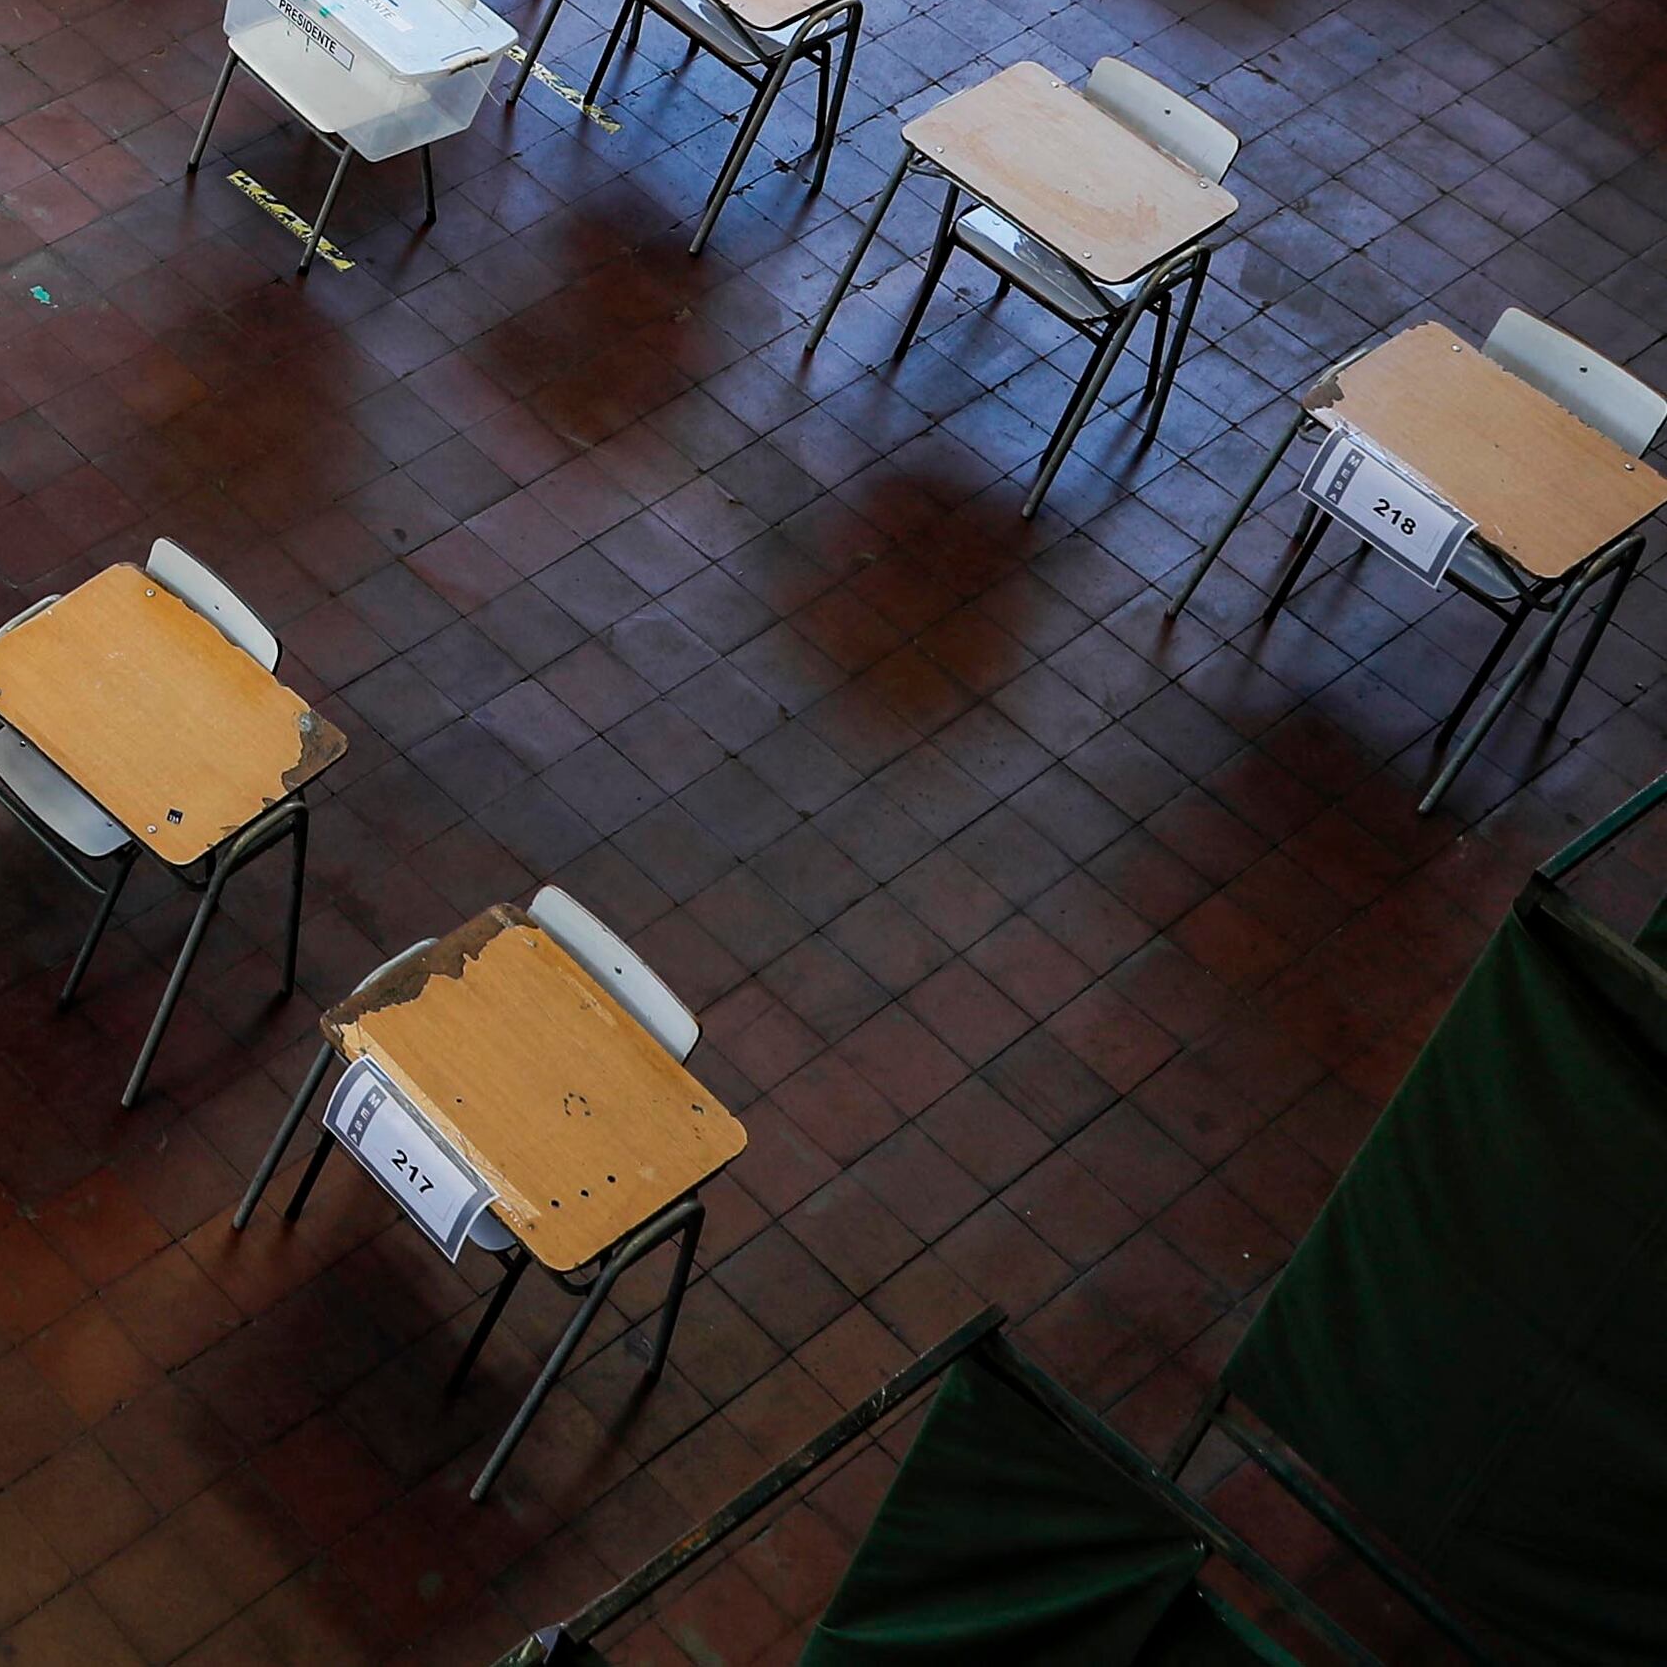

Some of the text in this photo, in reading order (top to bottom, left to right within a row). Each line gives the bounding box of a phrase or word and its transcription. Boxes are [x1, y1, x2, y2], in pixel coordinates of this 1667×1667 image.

[1329, 454, 1361, 502] MESA
[1372, 498, 1417, 536] 218
[350, 1093, 381, 1143] MESA
[391, 1149, 435, 1194] 217
